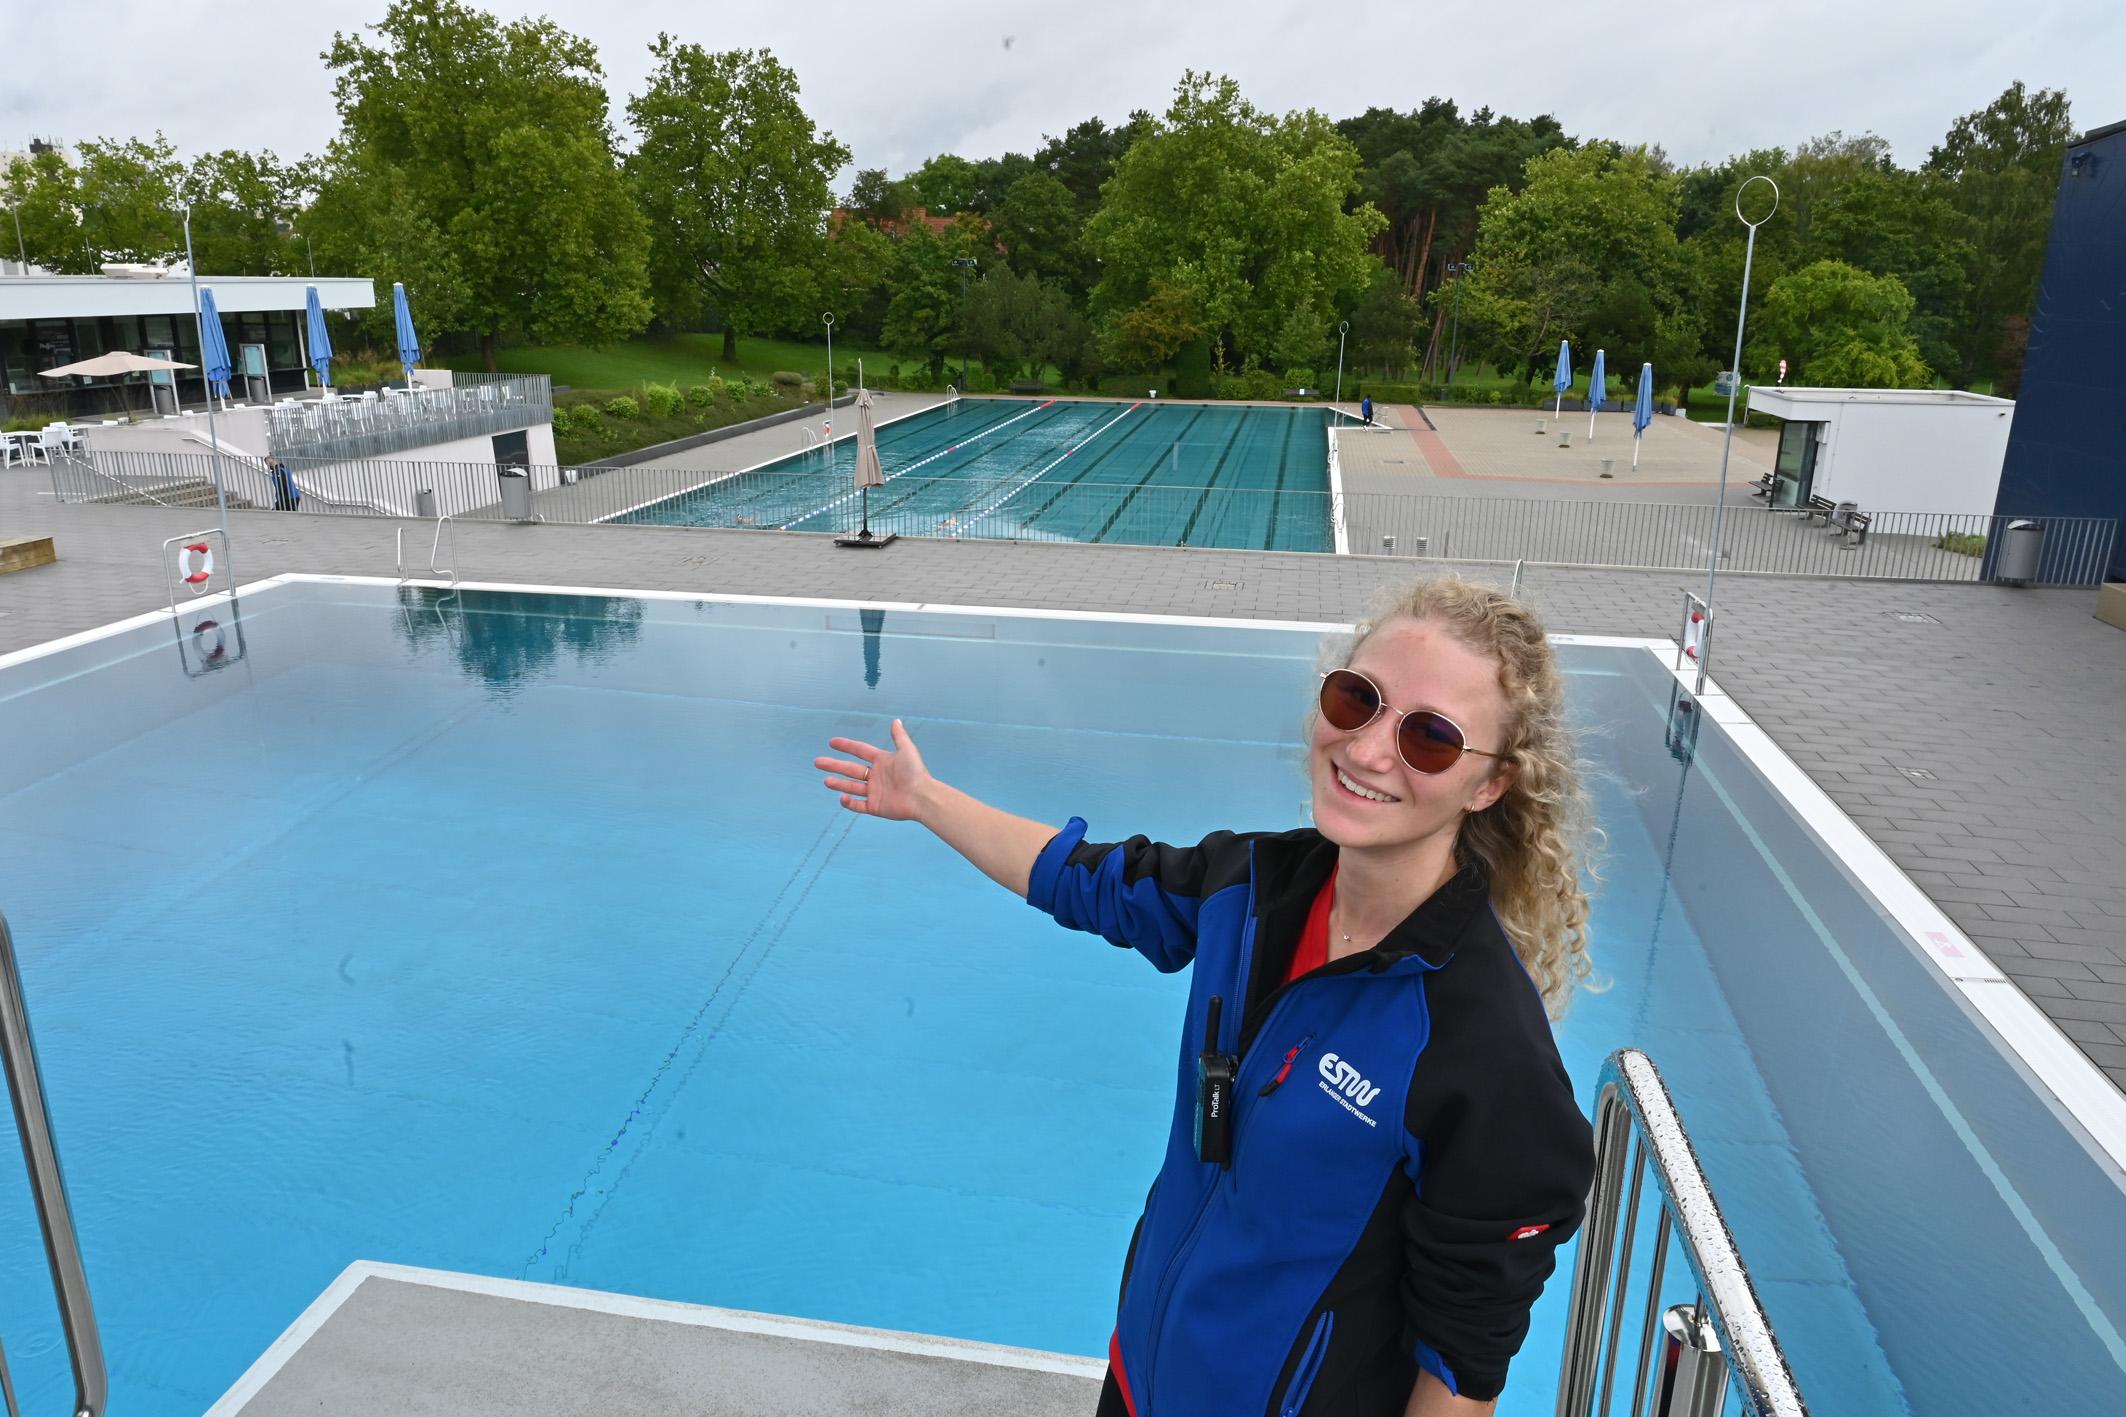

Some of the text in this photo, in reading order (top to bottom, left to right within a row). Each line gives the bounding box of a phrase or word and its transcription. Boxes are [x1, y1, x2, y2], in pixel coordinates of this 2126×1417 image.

[1319, 1053, 1381, 1106] ESTW
[1211, 1091, 1220, 1118] ProTalk
[1340, 1099, 1377, 1127] STADTWERKE
